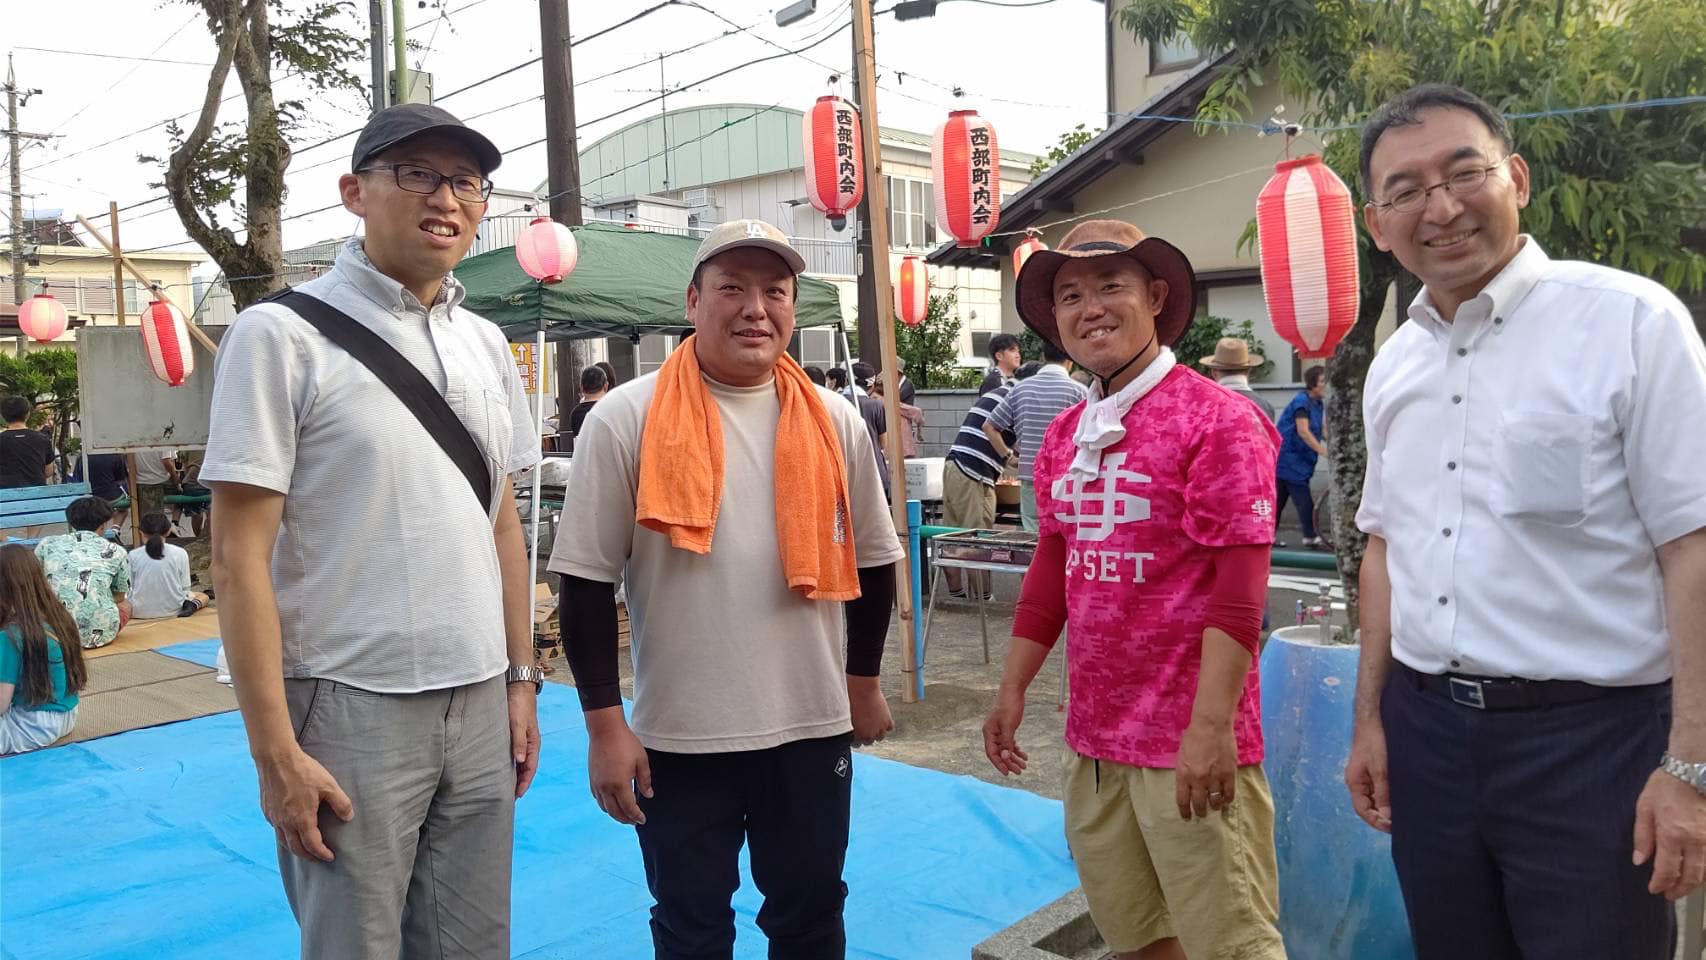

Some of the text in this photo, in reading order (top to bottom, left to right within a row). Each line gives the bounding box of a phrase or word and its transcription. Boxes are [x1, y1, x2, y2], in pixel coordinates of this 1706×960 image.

[836, 109, 856, 195] 西部町内会
[970, 127, 991, 225] 西部町内会
[747, 221, 768, 238] LA
